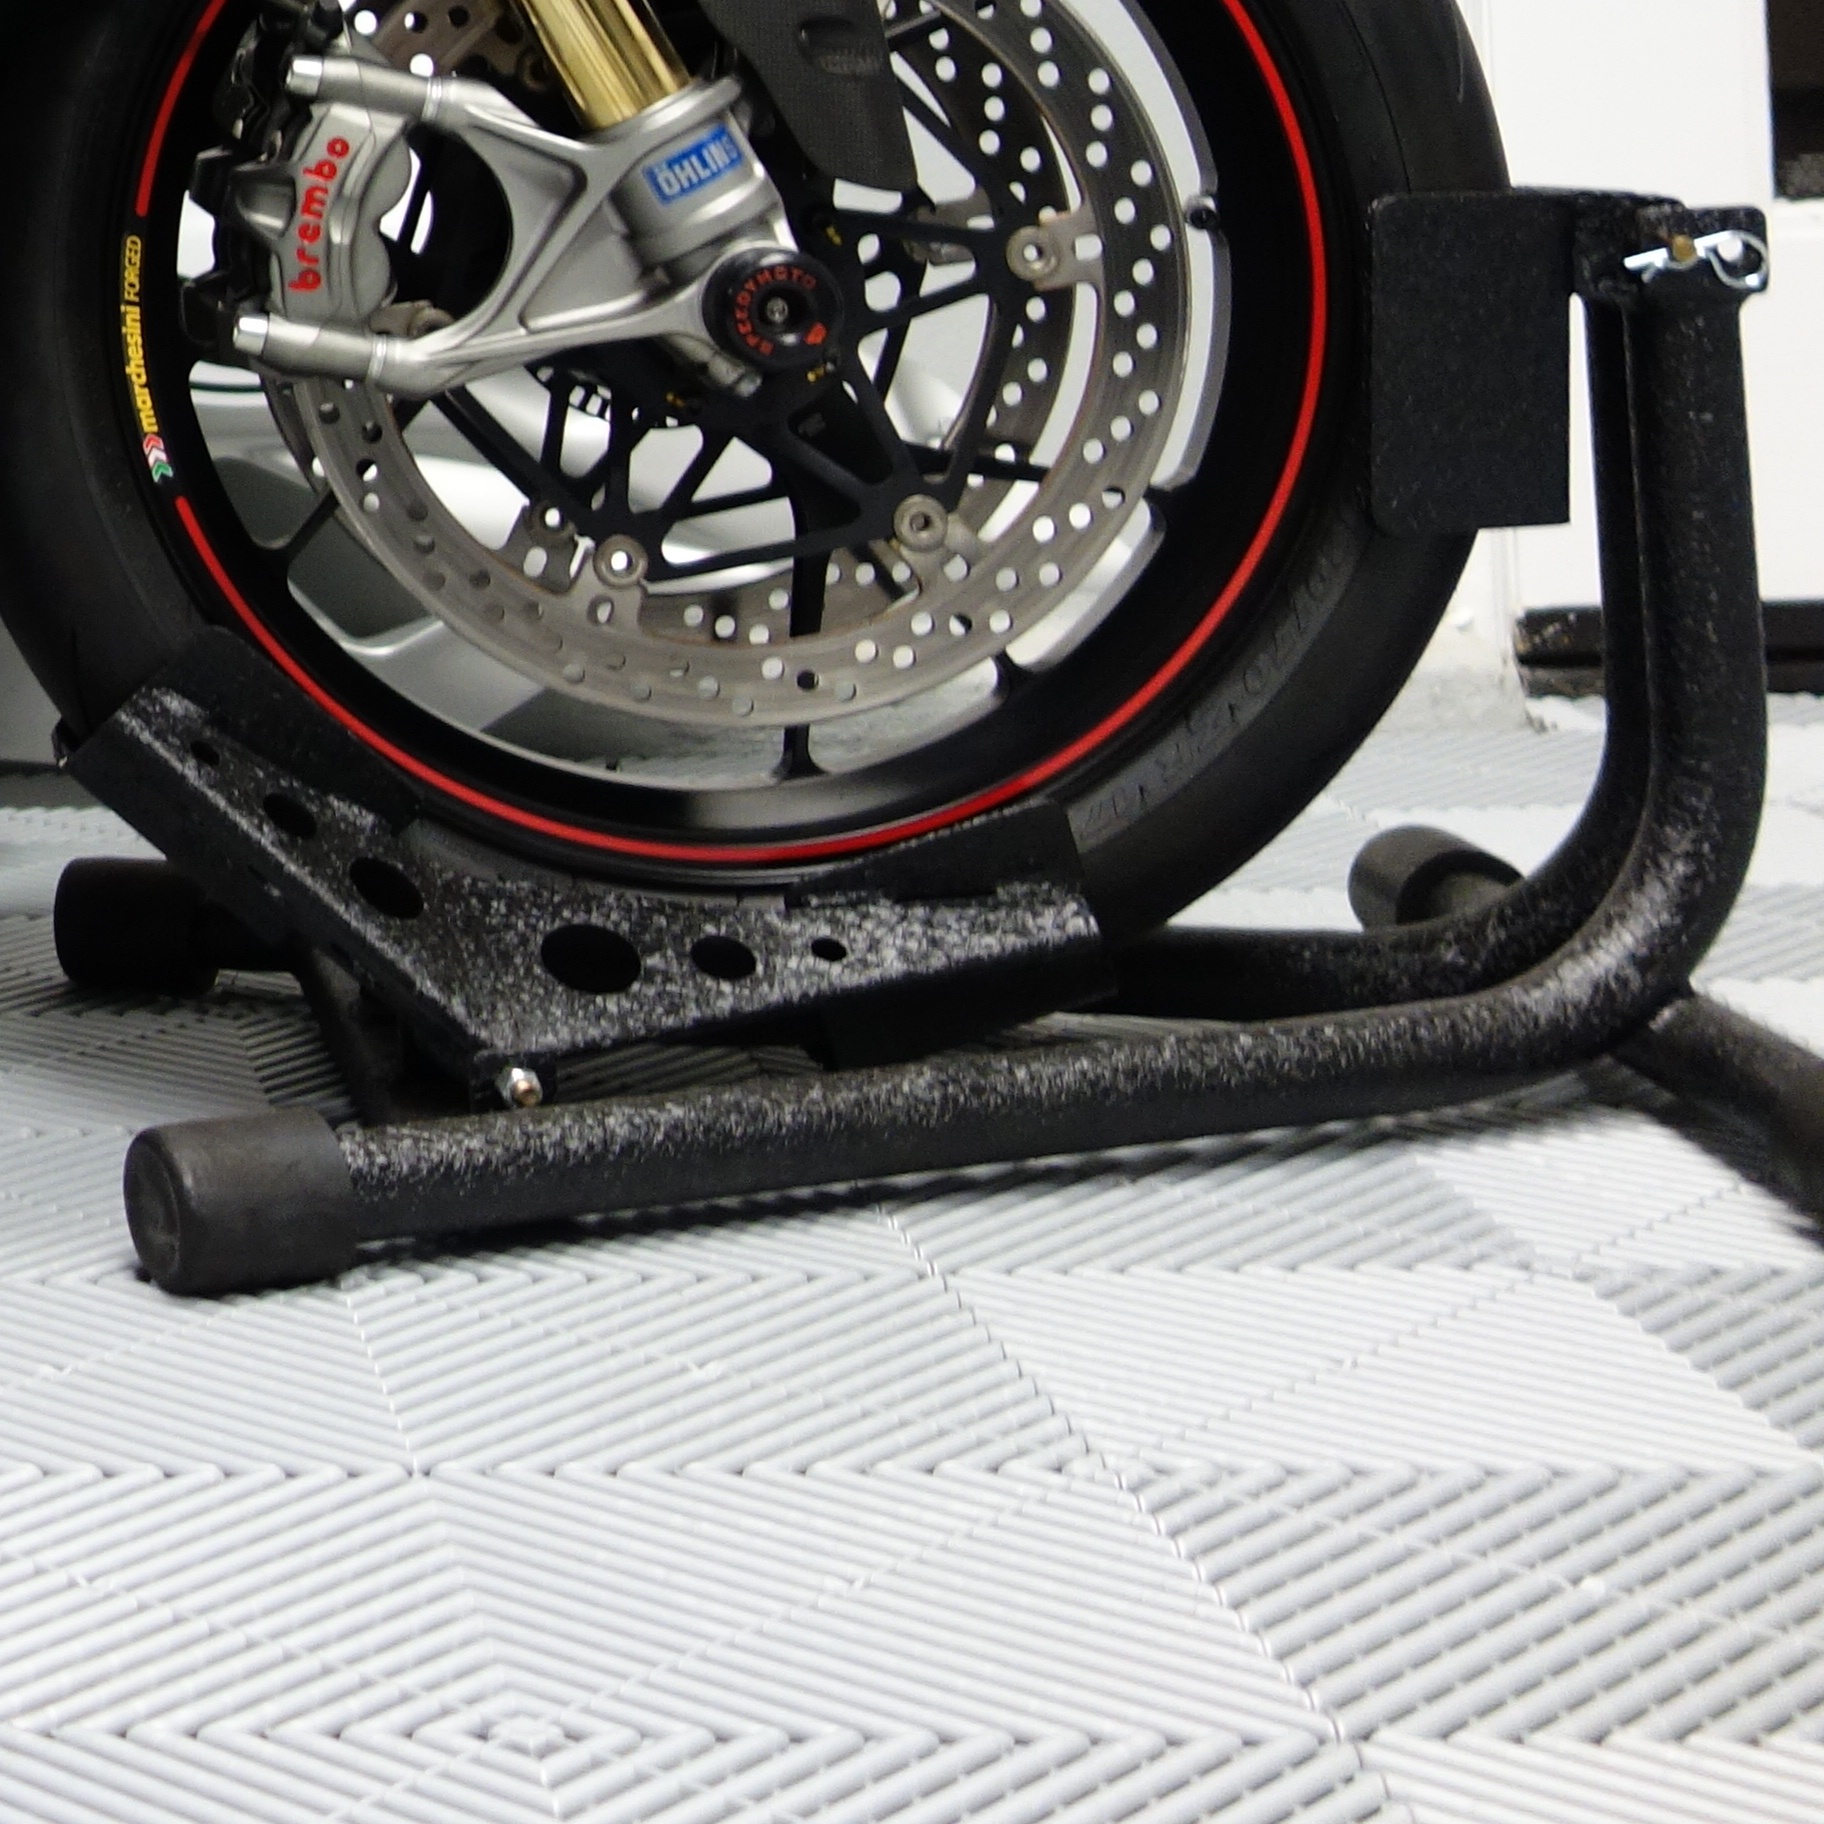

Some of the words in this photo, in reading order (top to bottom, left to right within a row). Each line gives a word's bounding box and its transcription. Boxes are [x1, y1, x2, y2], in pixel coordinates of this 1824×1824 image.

[124, 234, 142, 302] FORGED
[288, 137, 350, 293] brembo
[120, 304, 159, 434] marchesini
